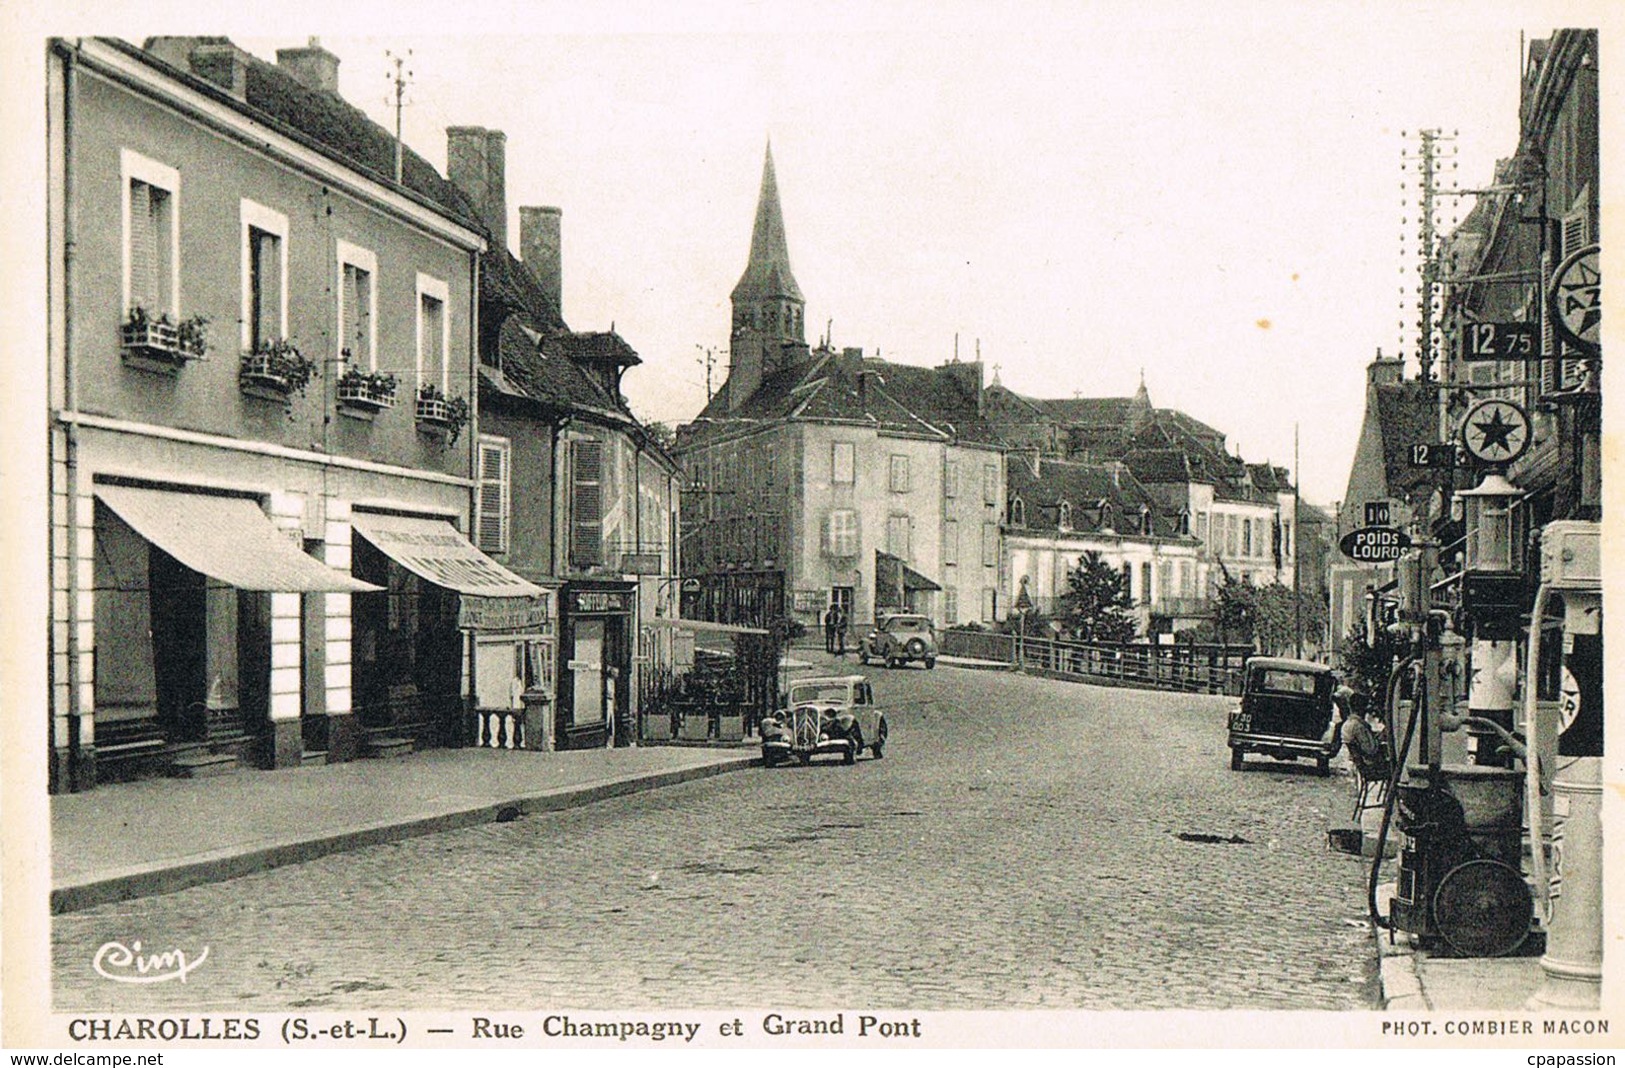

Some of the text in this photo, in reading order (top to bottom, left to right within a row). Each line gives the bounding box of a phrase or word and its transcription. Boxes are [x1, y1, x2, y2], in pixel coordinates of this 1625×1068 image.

[1472, 323, 1532, 354] 12 75
[1413, 444, 1429, 464] 12
[1357, 530, 1399, 545] POIDS
[1353, 545, 1409, 559] LOURDS
